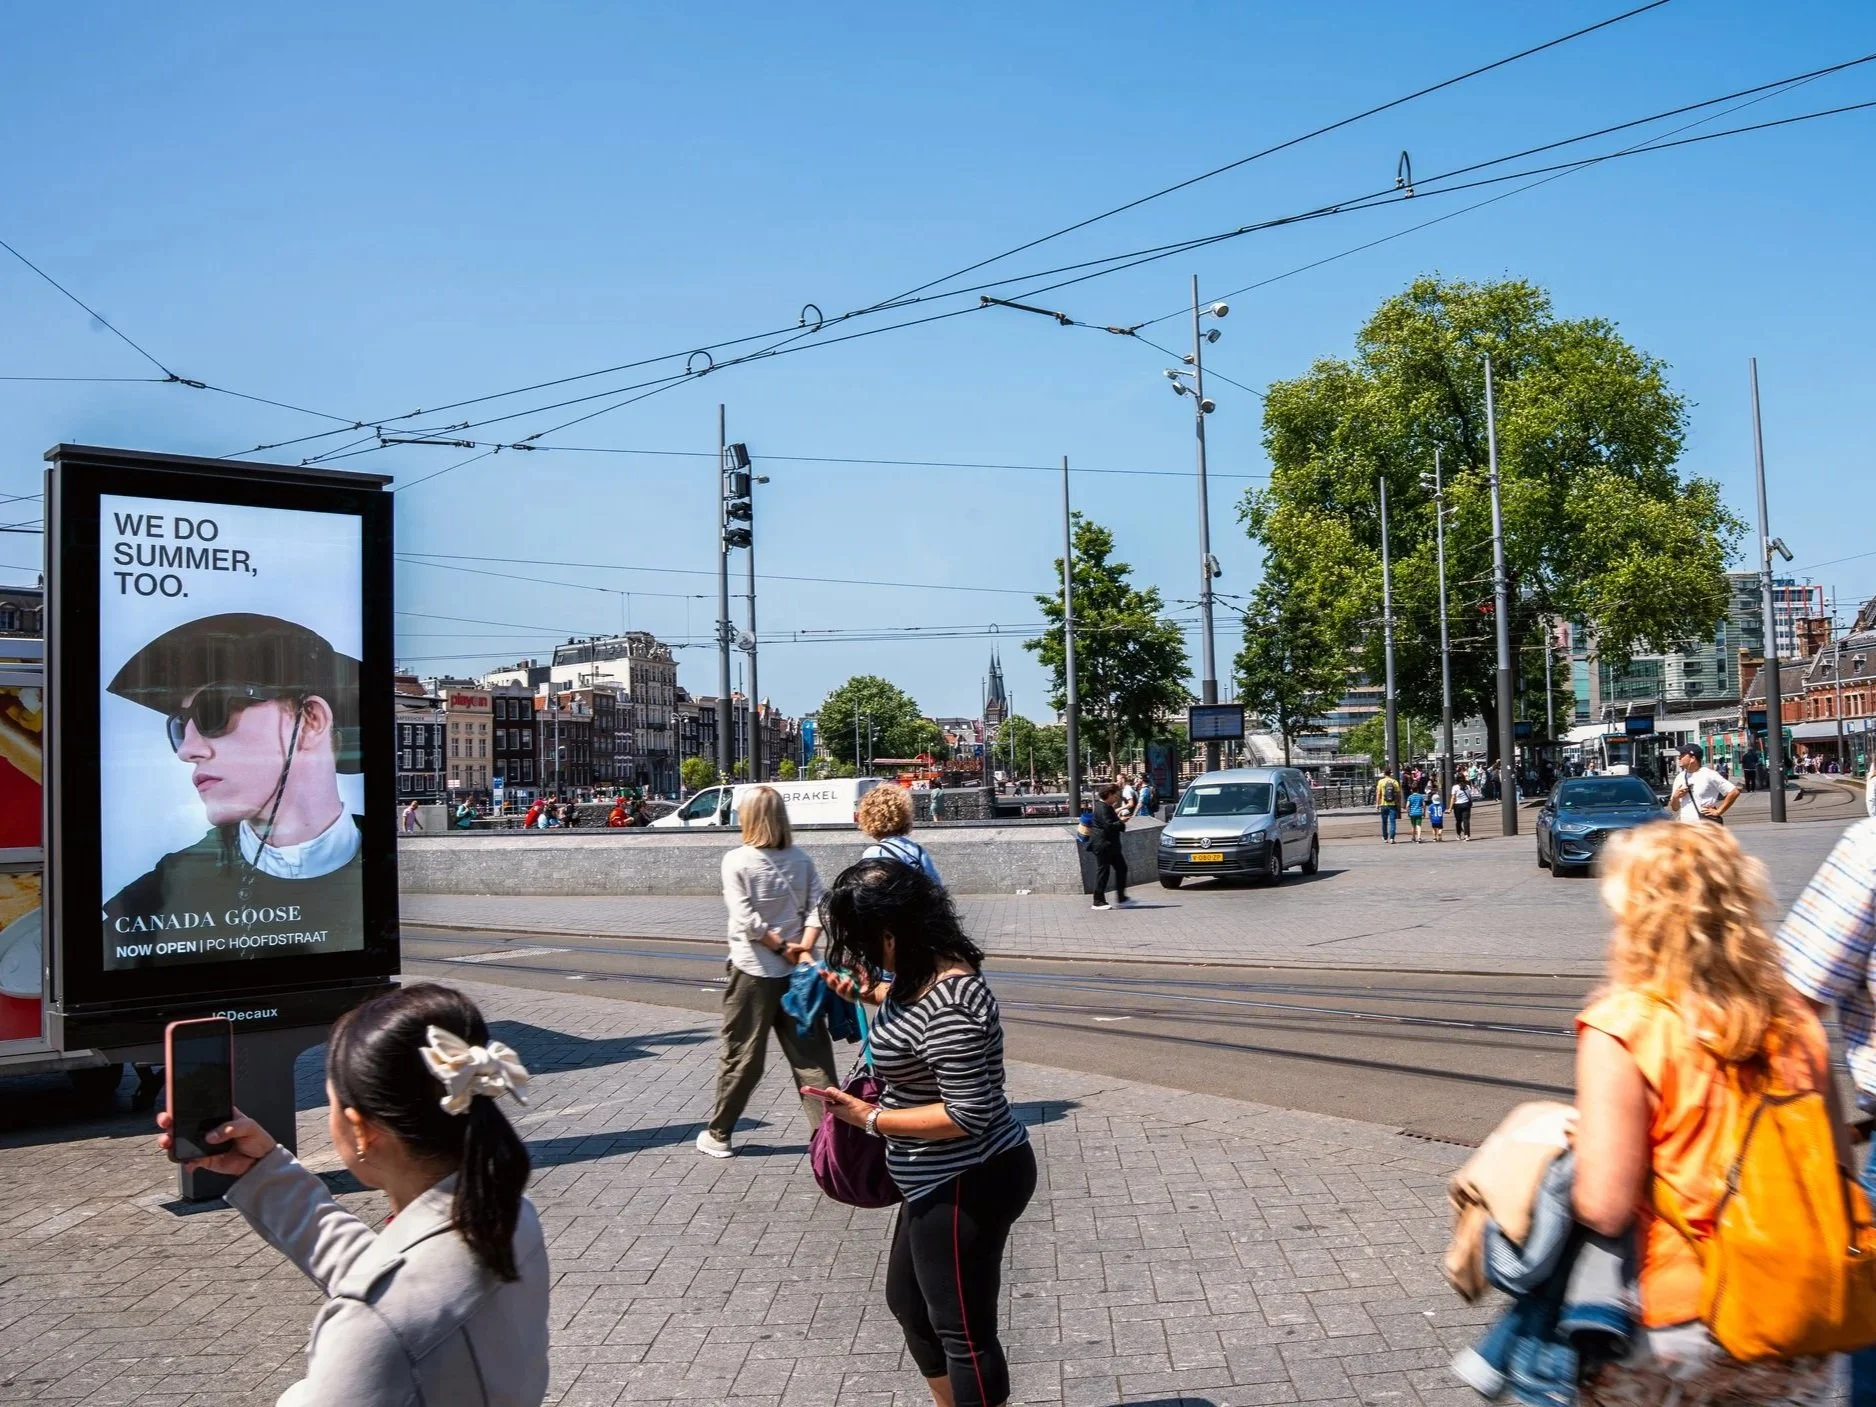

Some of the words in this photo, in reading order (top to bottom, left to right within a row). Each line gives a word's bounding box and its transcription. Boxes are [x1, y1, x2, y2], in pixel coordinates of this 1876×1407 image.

[114, 512, 164, 538] WE
[174, 517, 219, 542] DO
[113, 542, 258, 577] SUMMER,
[113, 571, 189, 598] TOO.
[783, 790, 839, 802] BRAKEL
[1433, 806, 1442, 816] 10
[115, 911, 216, 934] CANADA
[225, 906, 302, 926] GOOSE
[116, 944, 152, 958] NOW
[156, 940, 197, 955] OPEN
[206, 938, 226, 950] PC
[229, 931, 329, 949] HOOFDSTRAAT
